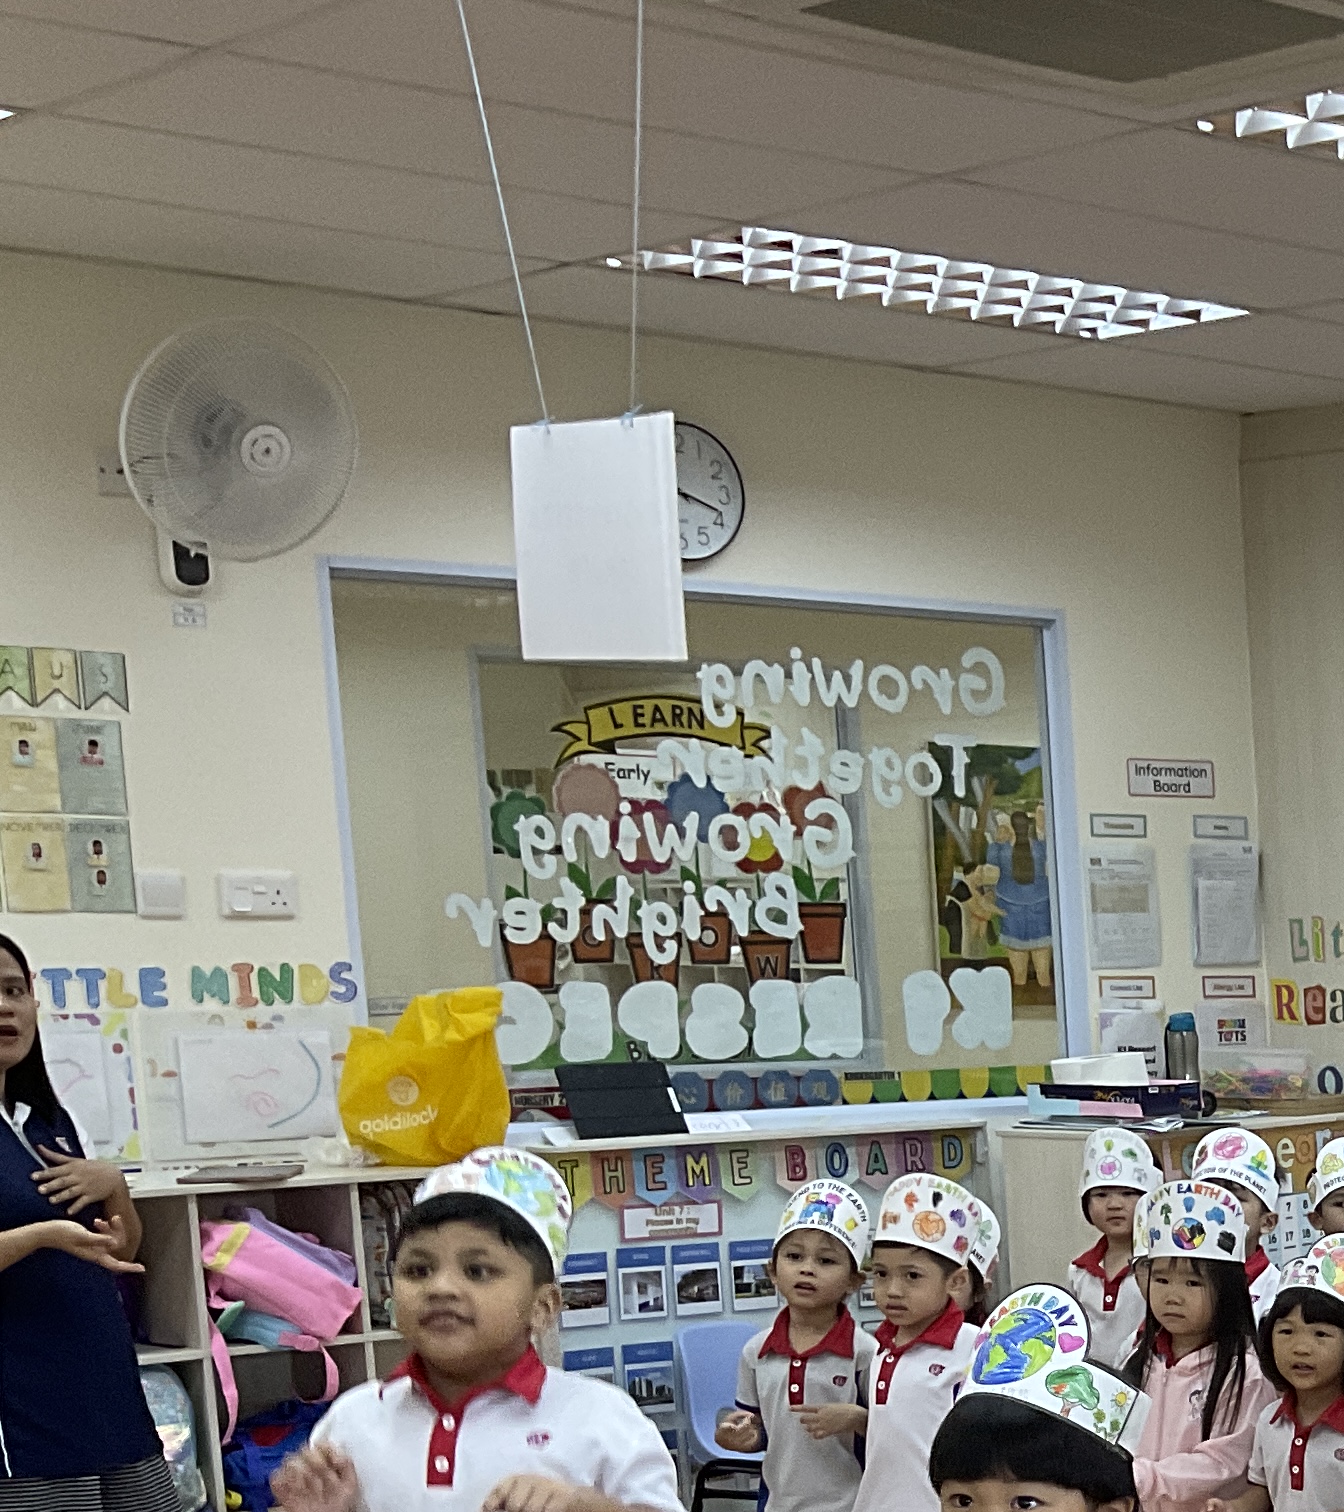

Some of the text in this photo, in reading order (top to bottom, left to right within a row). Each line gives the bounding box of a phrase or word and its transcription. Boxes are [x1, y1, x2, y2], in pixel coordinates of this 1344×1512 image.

[718, 485, 731, 505] 3
[698, 526, 710, 546] 5
[604, 761, 651, 786] Early
[1134, 763, 1208, 779] Information
[1153, 779, 1191, 794] Board
[33, 961, 358, 1009] TTLE MINDS
[558, 1134, 964, 1197] THEME BOARD
[828, 1182, 846, 1195] THE
[1176, 1183, 1222, 1200] EARTH
[988, 1291, 1079, 1328] EARTH DAY
